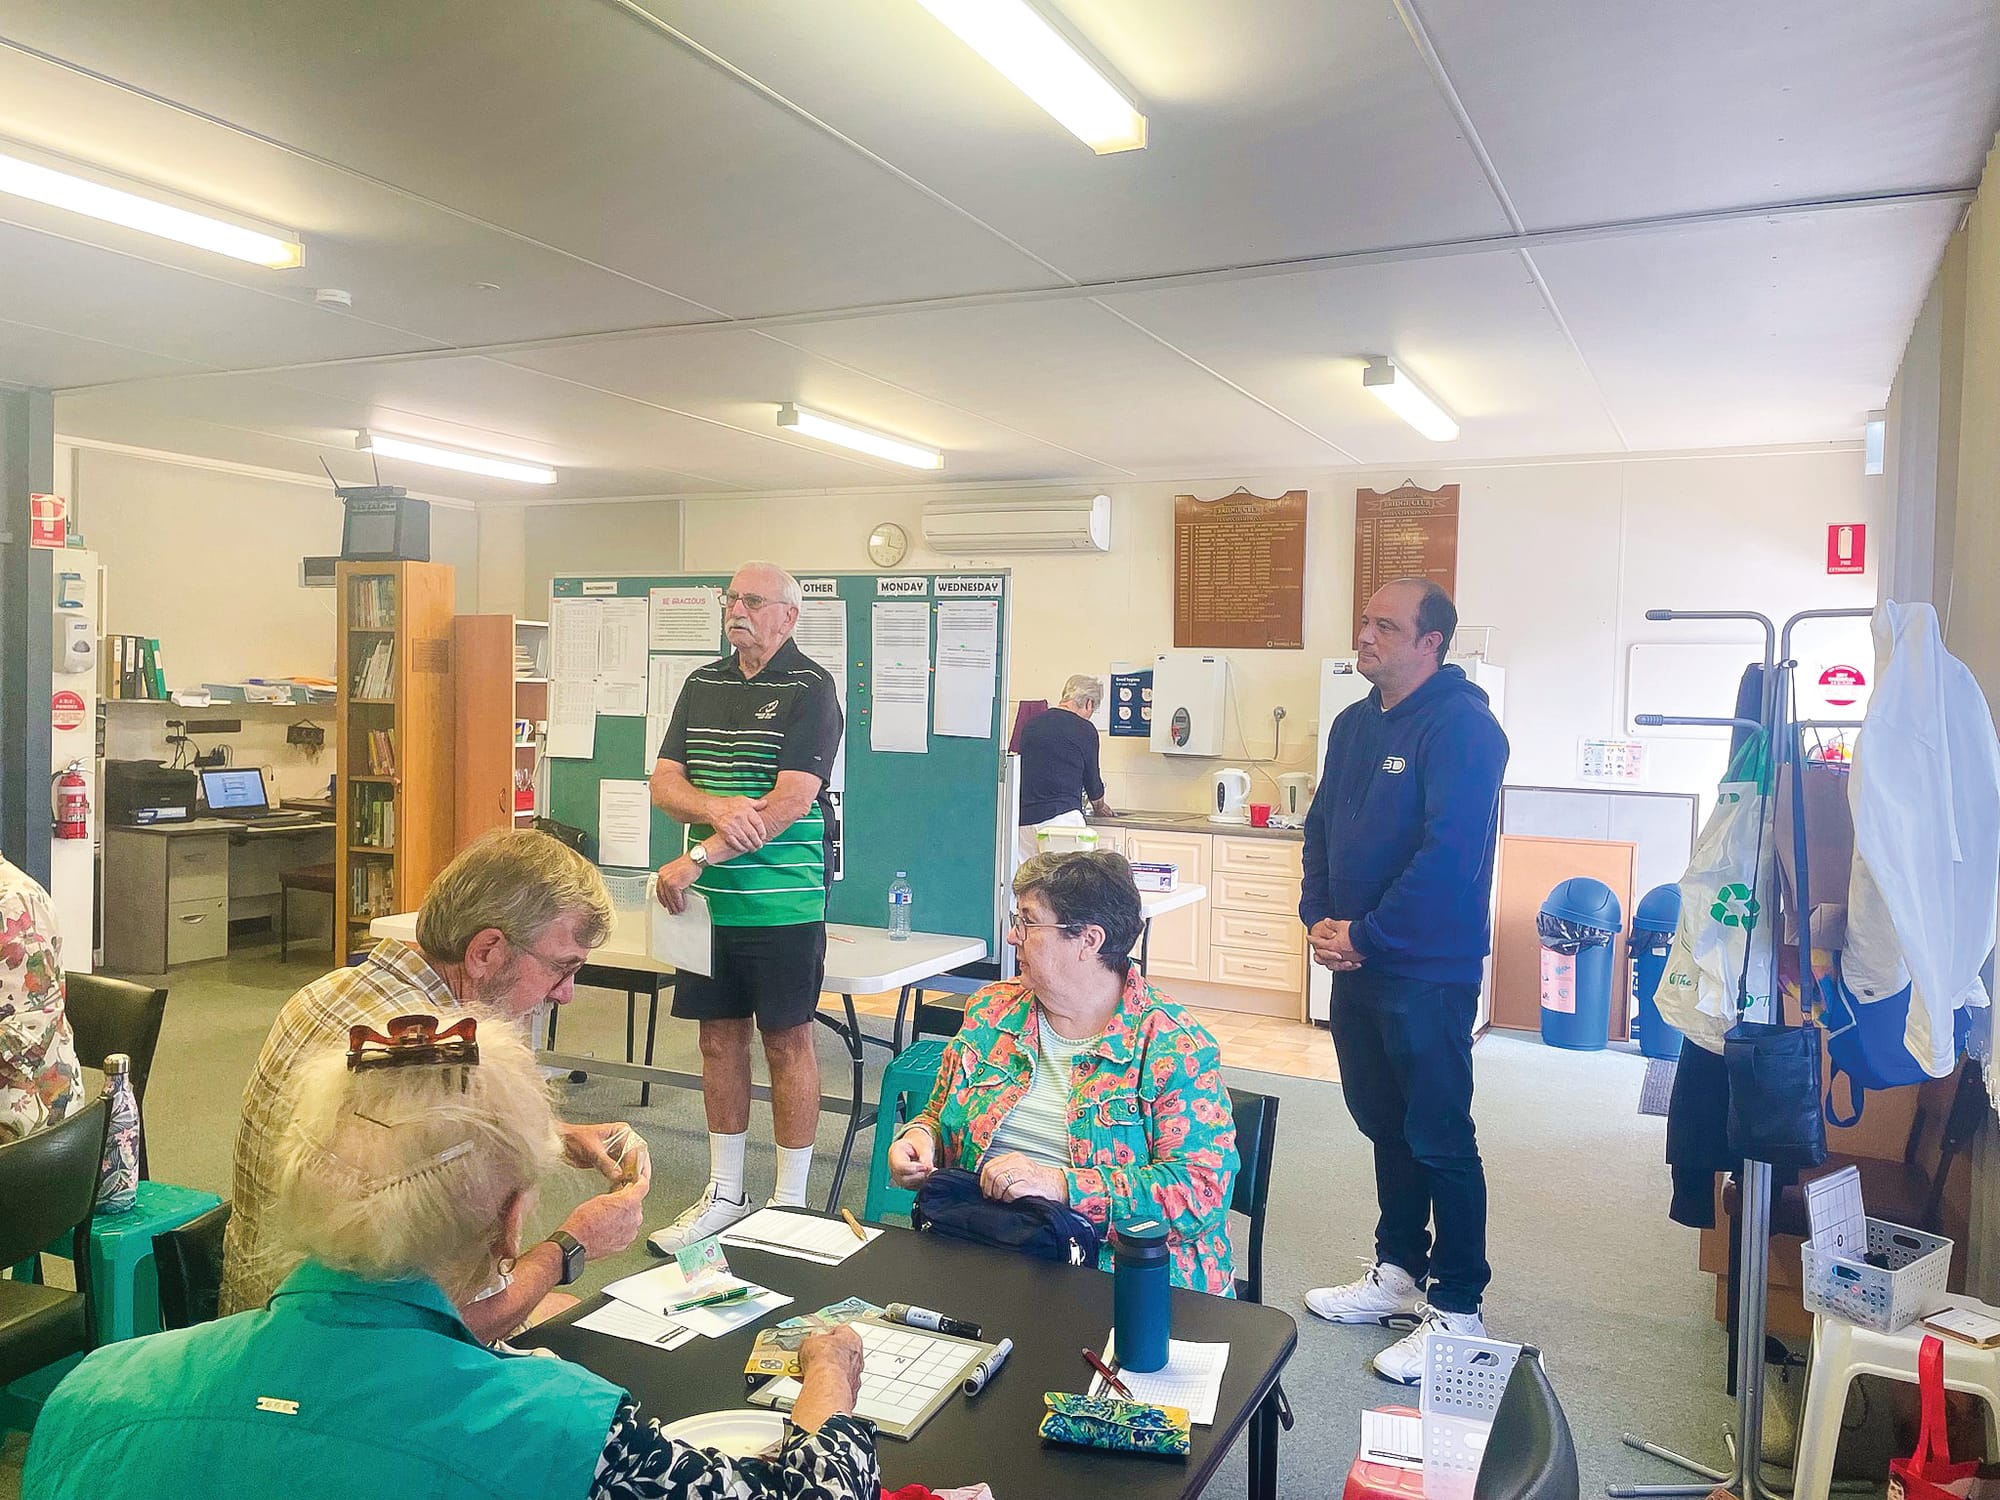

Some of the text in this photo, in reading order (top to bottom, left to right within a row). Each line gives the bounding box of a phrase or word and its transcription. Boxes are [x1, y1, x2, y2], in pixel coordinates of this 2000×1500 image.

[803, 583, 833, 592] OTHER
[881, 582, 924, 592] MONDAY
[938, 582, 999, 592] WEDNESDAY
